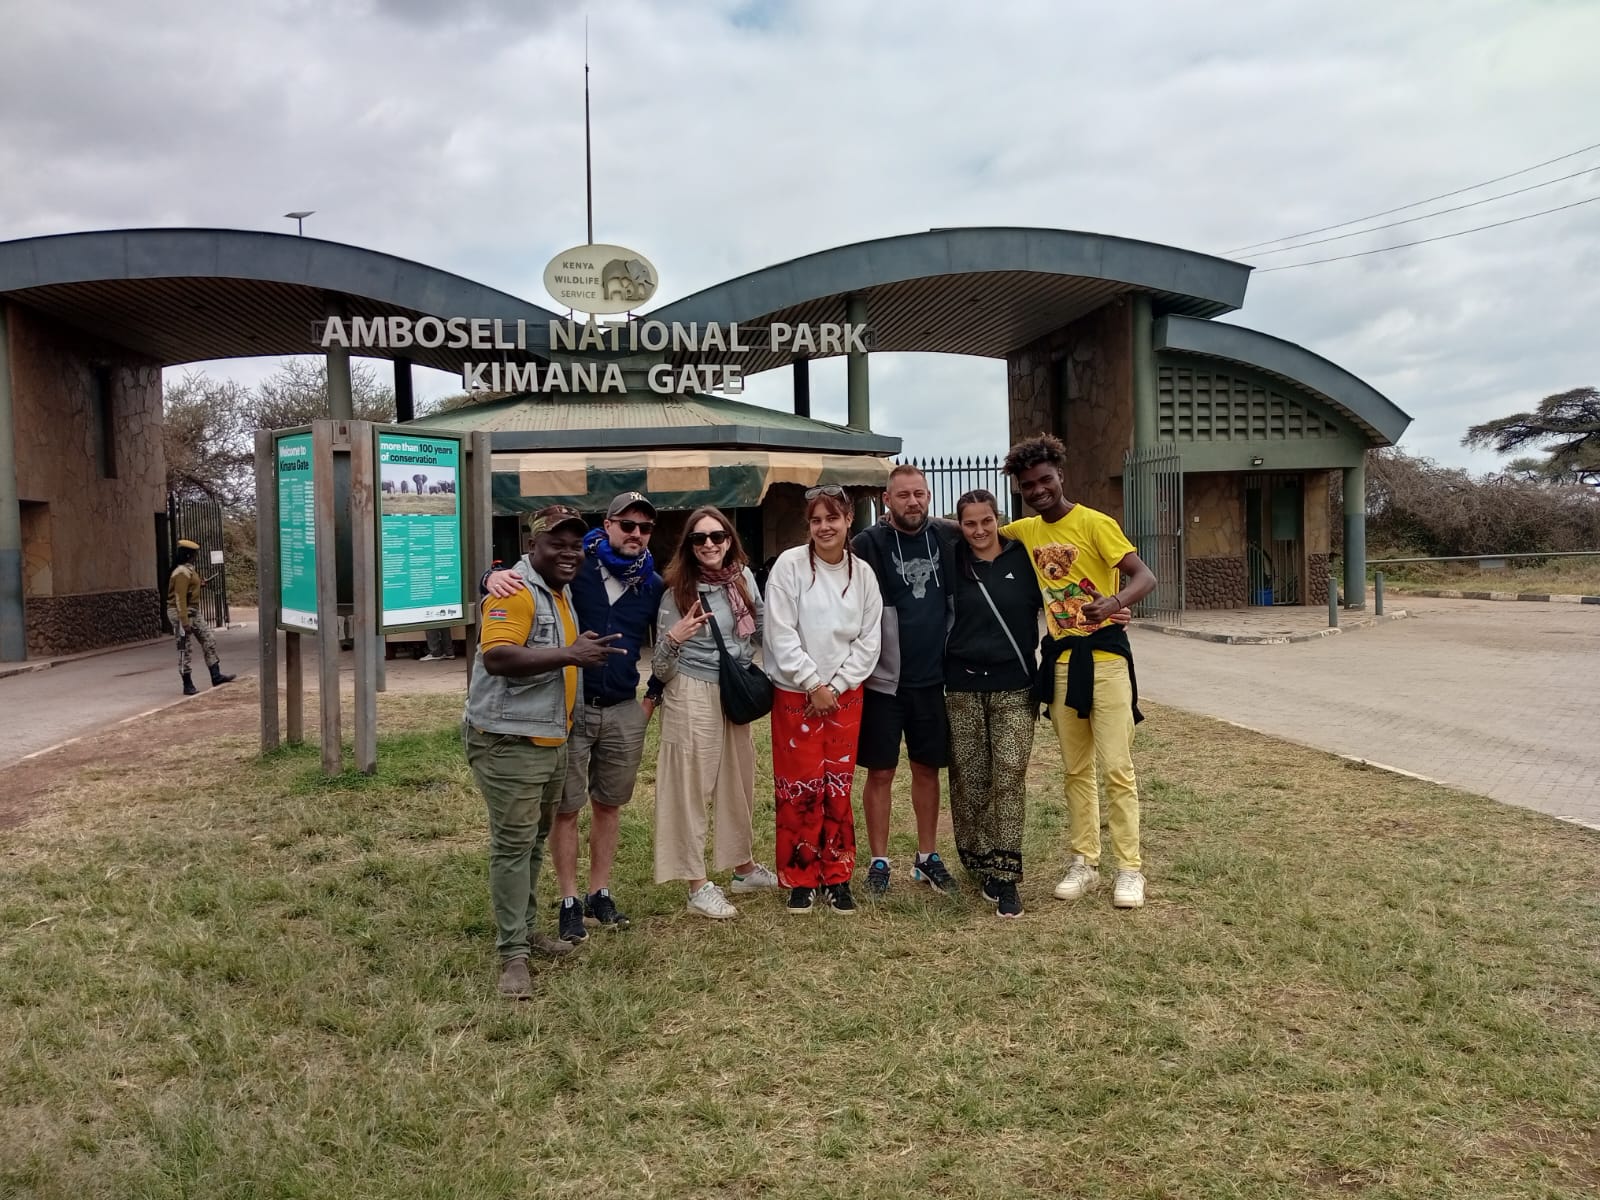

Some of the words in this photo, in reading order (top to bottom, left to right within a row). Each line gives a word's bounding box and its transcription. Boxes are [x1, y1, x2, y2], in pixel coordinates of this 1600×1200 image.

[562, 261, 594, 270] KENYA
[554, 275, 600, 285] WILDLIFE
[561, 290, 597, 299] SERVICE
[321, 315, 527, 350] AMBOSELI
[549, 319, 749, 353] NATIONAL
[770, 322, 868, 354] PARK
[463, 361, 628, 394] KIMANA
[647, 363, 744, 395] GATE
[279, 446, 300, 457] Welcome
[300, 445, 307, 456] to
[402, 441, 418, 452] than
[419, 443, 433, 453] 100
[434, 446, 453, 455] years
[381, 452, 389, 461] of
[390, 454, 437, 464] conservation
[280, 460, 297, 472] Kimana
[297, 459, 309, 471] Gate
